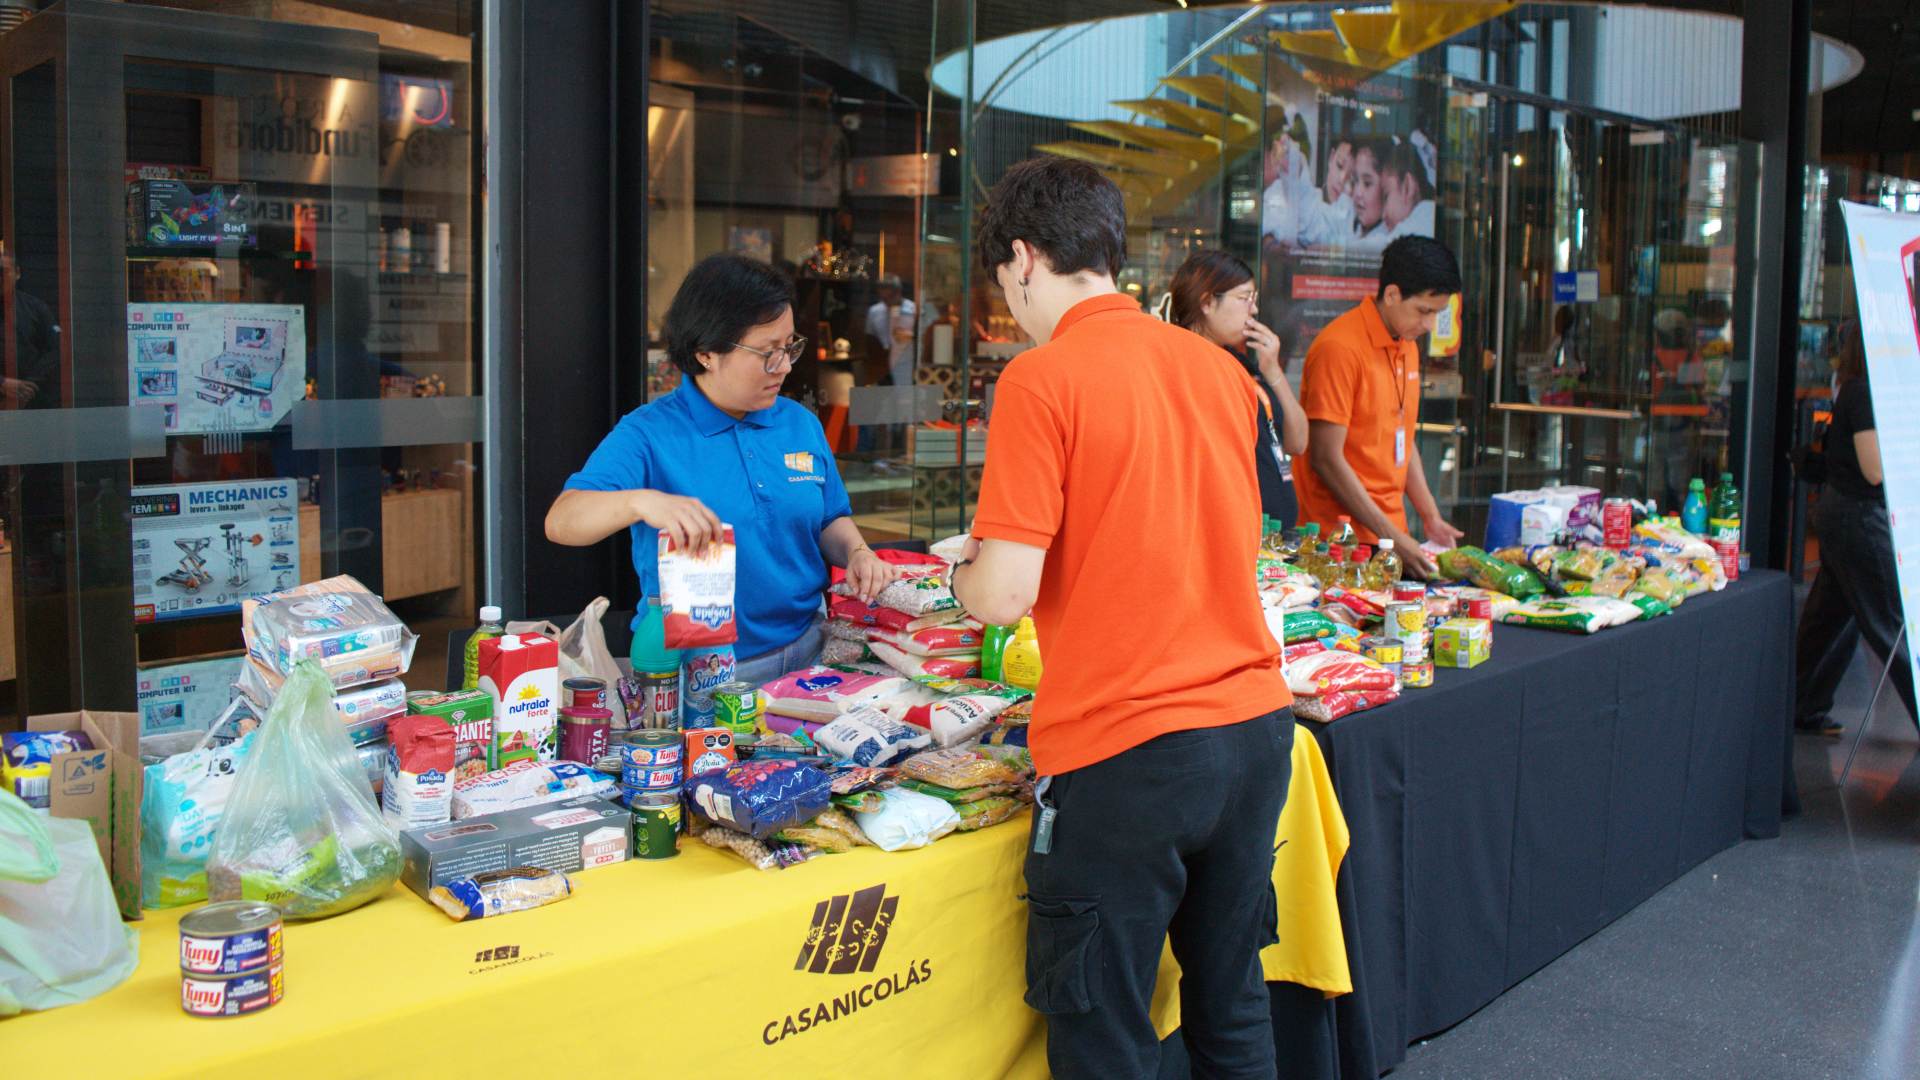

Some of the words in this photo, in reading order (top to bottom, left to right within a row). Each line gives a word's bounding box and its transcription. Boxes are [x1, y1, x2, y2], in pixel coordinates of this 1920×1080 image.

[176, 323, 190, 331] KIT
[189, 486, 288, 505] MECHANICS
[218, 503, 245, 512] linkages
[183, 685, 197, 693] KIT
[527, 708, 549, 718] forte
[420, 774, 444, 782] Posada
[652, 771, 673, 784] Tuny
[184, 940, 220, 964] Tuny
[185, 982, 222, 1008] Tuny
[762, 959, 932, 1046] CASANICOLÁS
